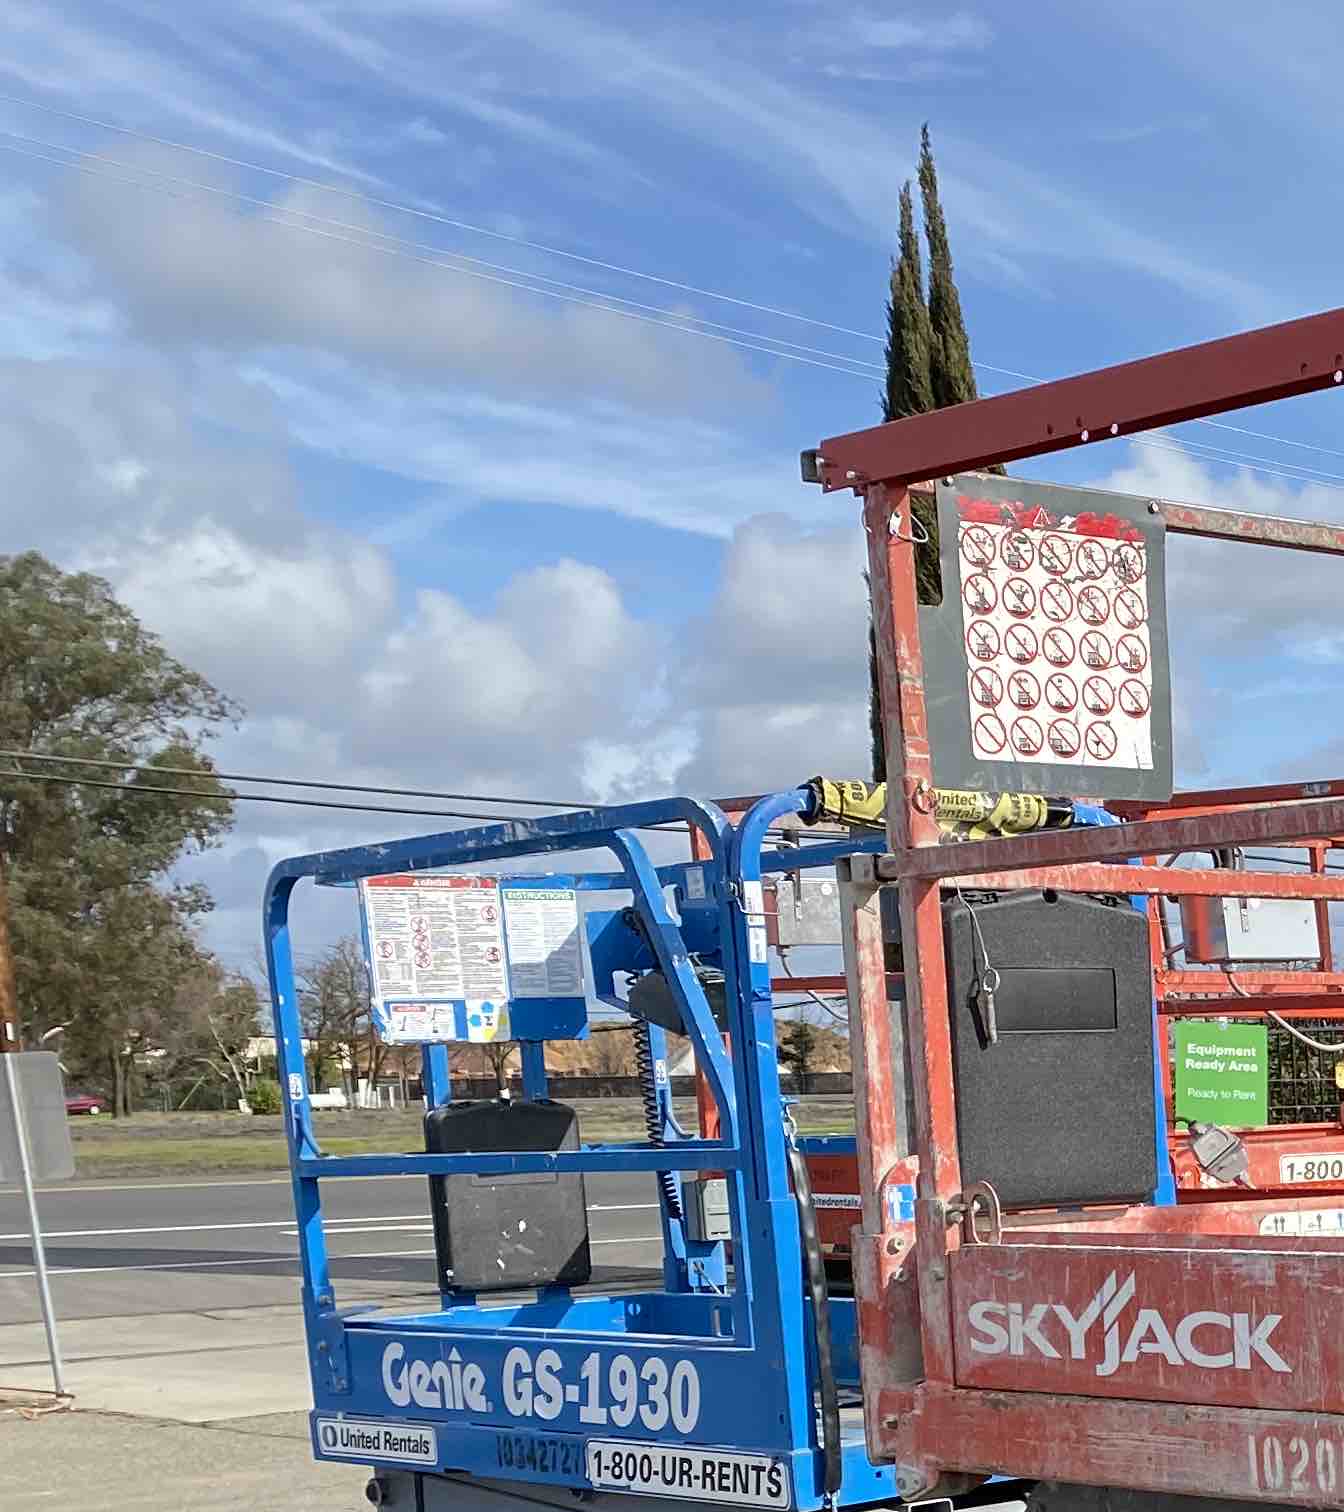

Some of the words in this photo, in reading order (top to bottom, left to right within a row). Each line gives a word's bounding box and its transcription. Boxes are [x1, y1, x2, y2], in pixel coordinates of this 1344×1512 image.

[1187, 1044, 1256, 1060] Equipment
[1185, 1060, 1225, 1073] Ready
[1229, 1061, 1258, 1073] Area
[1187, 1088, 1218, 1100] Ready
[1220, 1090, 1232, 1099] to
[1233, 1089, 1256, 1101] Rent
[968, 1270, 1292, 1376] SKYJACK
[381, 1342, 487, 1414] Genie
[503, 1347, 700, 1435] GS-1930
[340, 1431, 380, 1449] United
[384, 1431, 430, 1455] Rentals
[593, 1449, 783, 1498] 1-800-UR-RENTS
